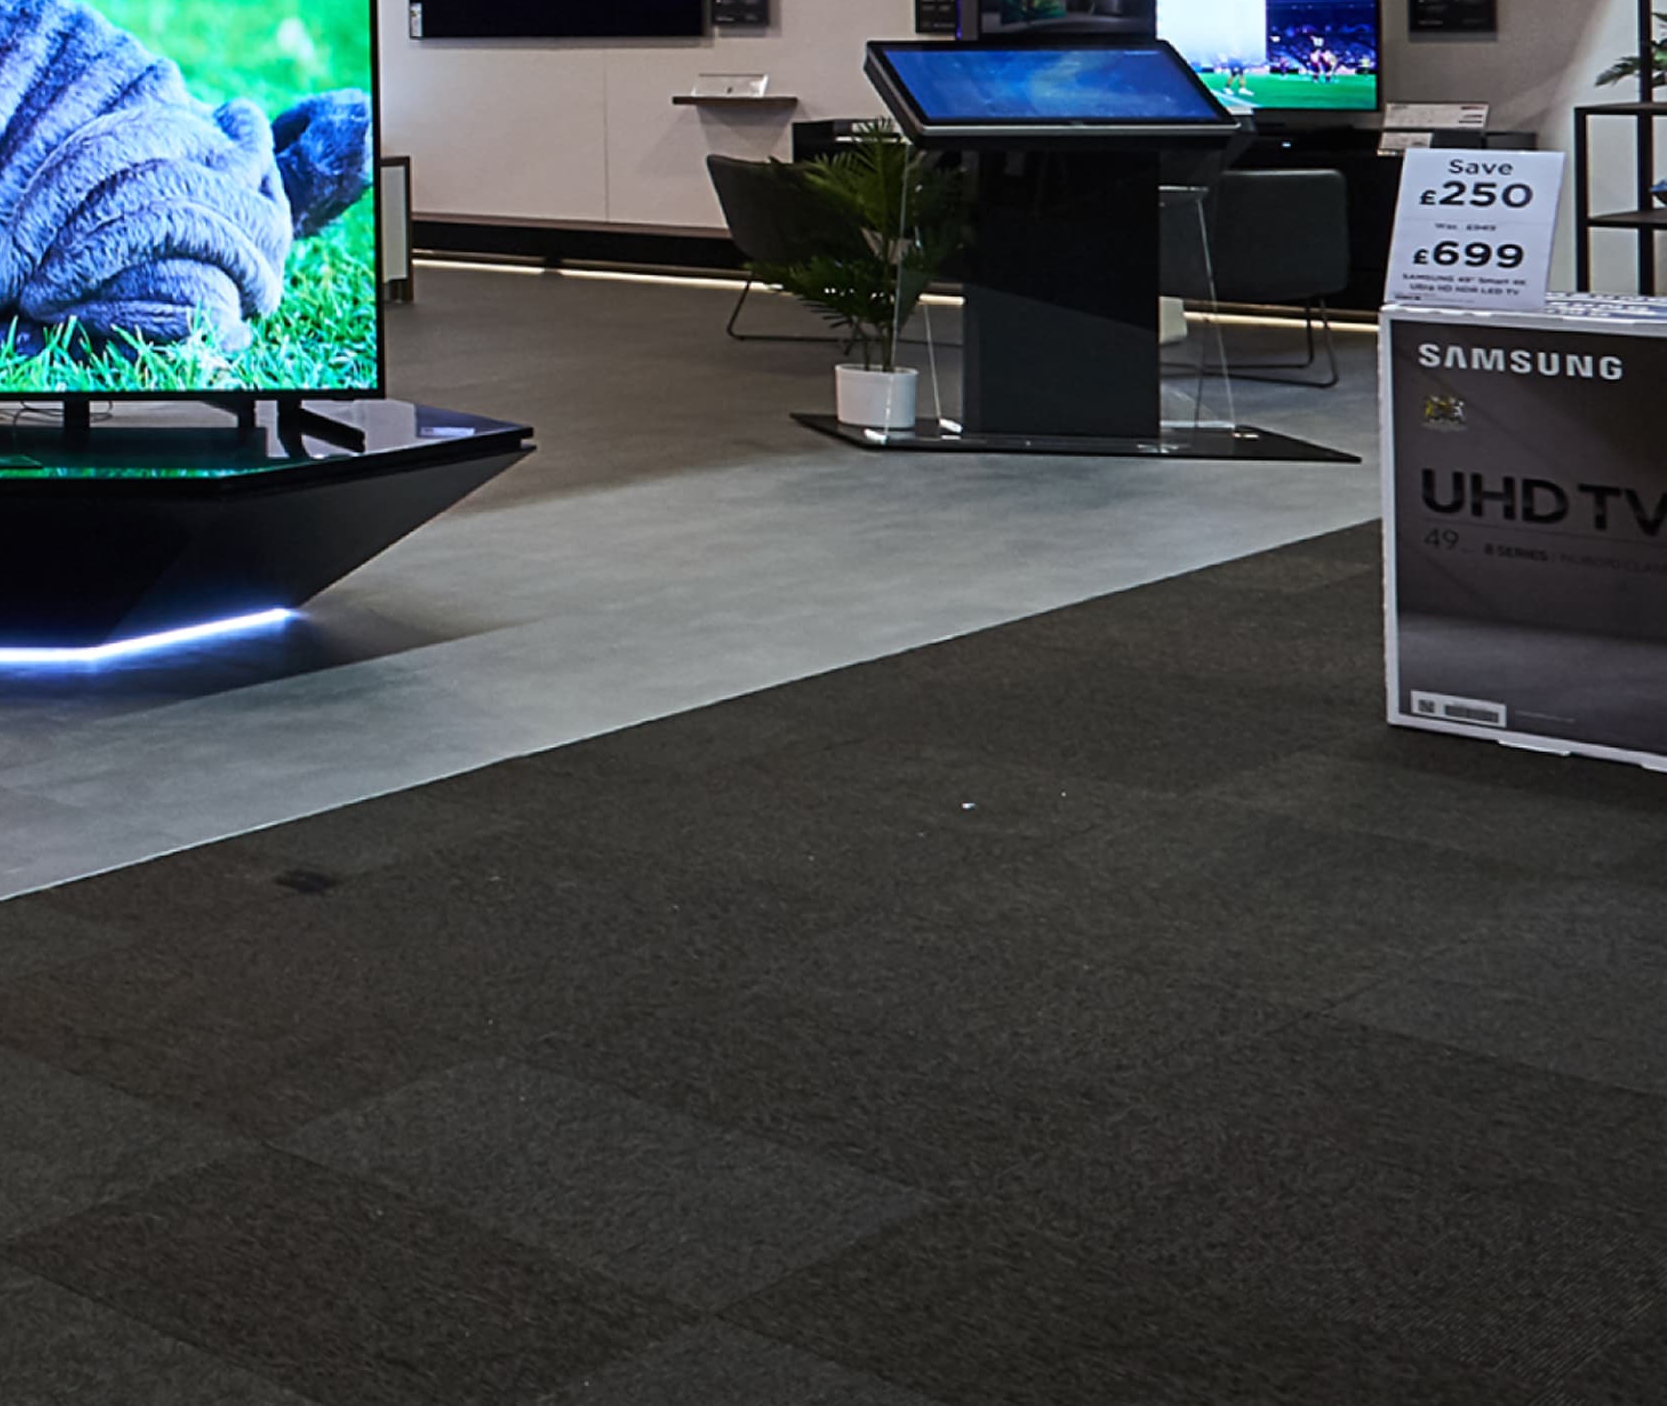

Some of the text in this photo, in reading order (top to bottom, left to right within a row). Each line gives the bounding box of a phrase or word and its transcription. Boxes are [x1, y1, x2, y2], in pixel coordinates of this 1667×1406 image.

[1448, 159, 1514, 175] Save
[1419, 180, 1533, 208] £250
[1413, 241, 1524, 268] £699
[1402, 274, 1454, 282] SAMSUNG
[1418, 344, 1623, 380] SAMSUNG
[1422, 468, 1667, 536] UHD TV
[1424, 528, 1459, 550] 49
